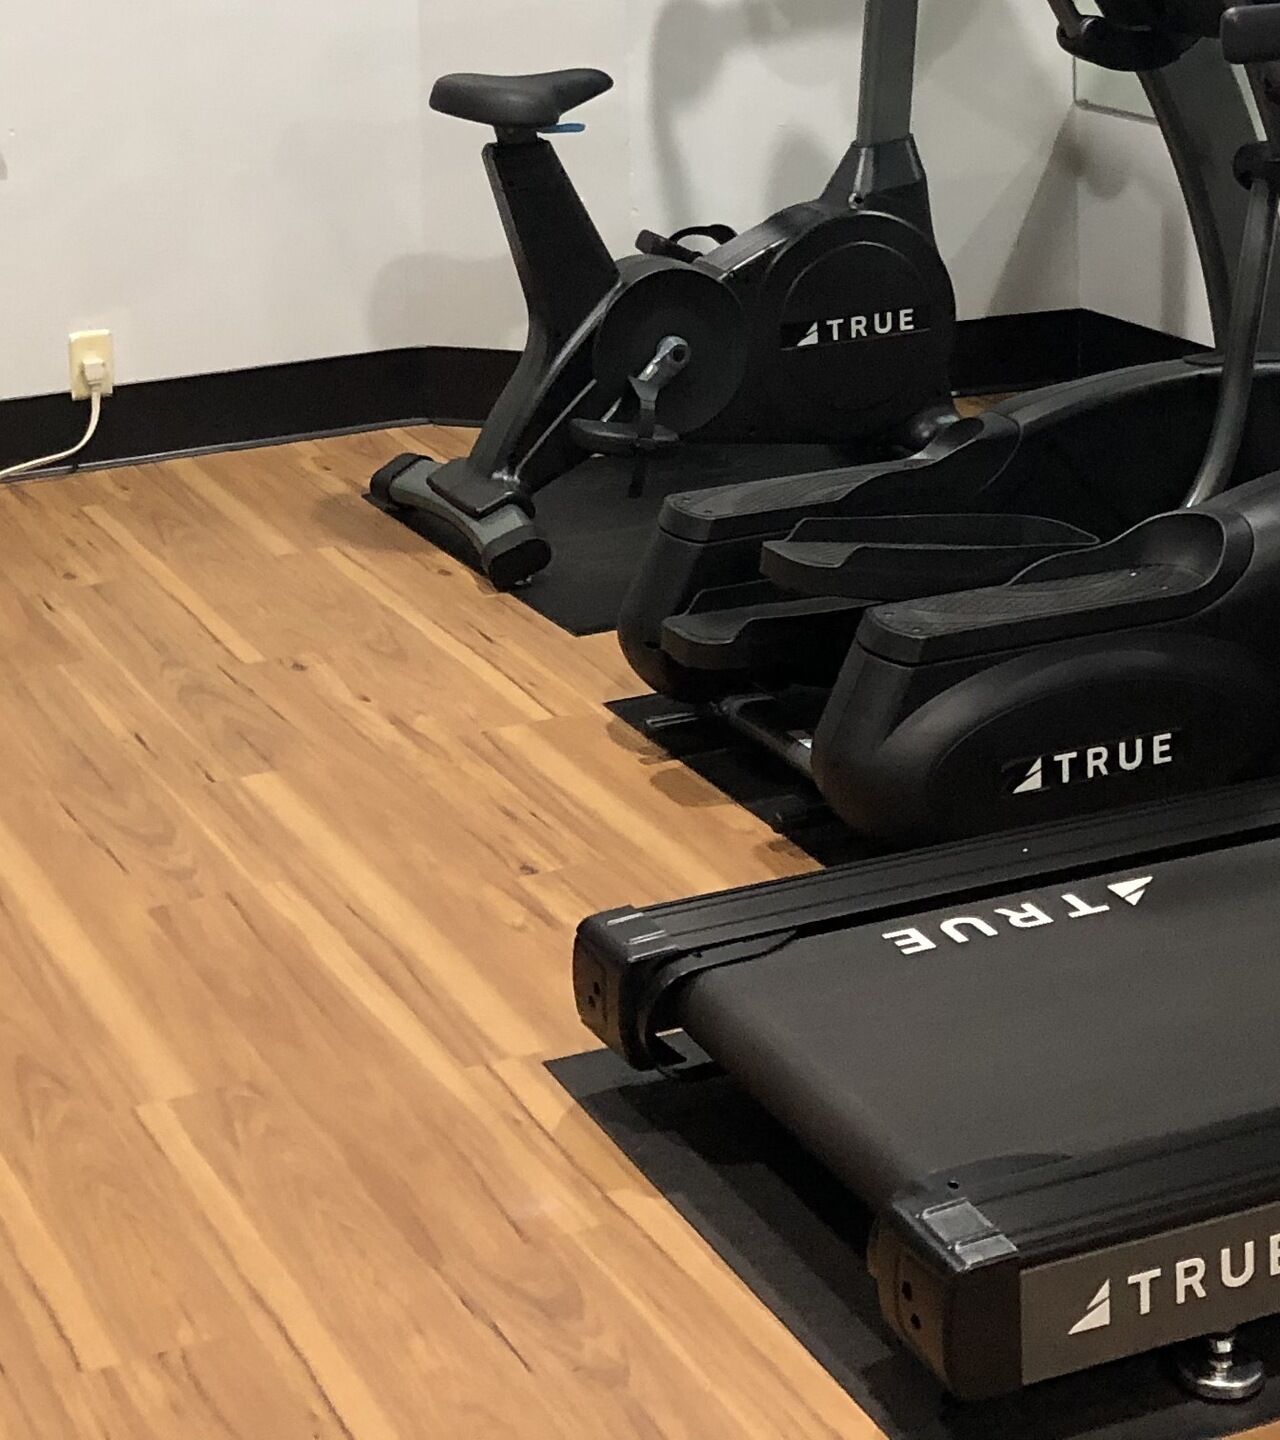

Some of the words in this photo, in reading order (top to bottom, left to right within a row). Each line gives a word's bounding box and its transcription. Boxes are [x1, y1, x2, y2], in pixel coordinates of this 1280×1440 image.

[826, 308, 915, 342] TRUE
[1053, 731, 1174, 783] TRUE
[881, 893, 1111, 956] TRUE
